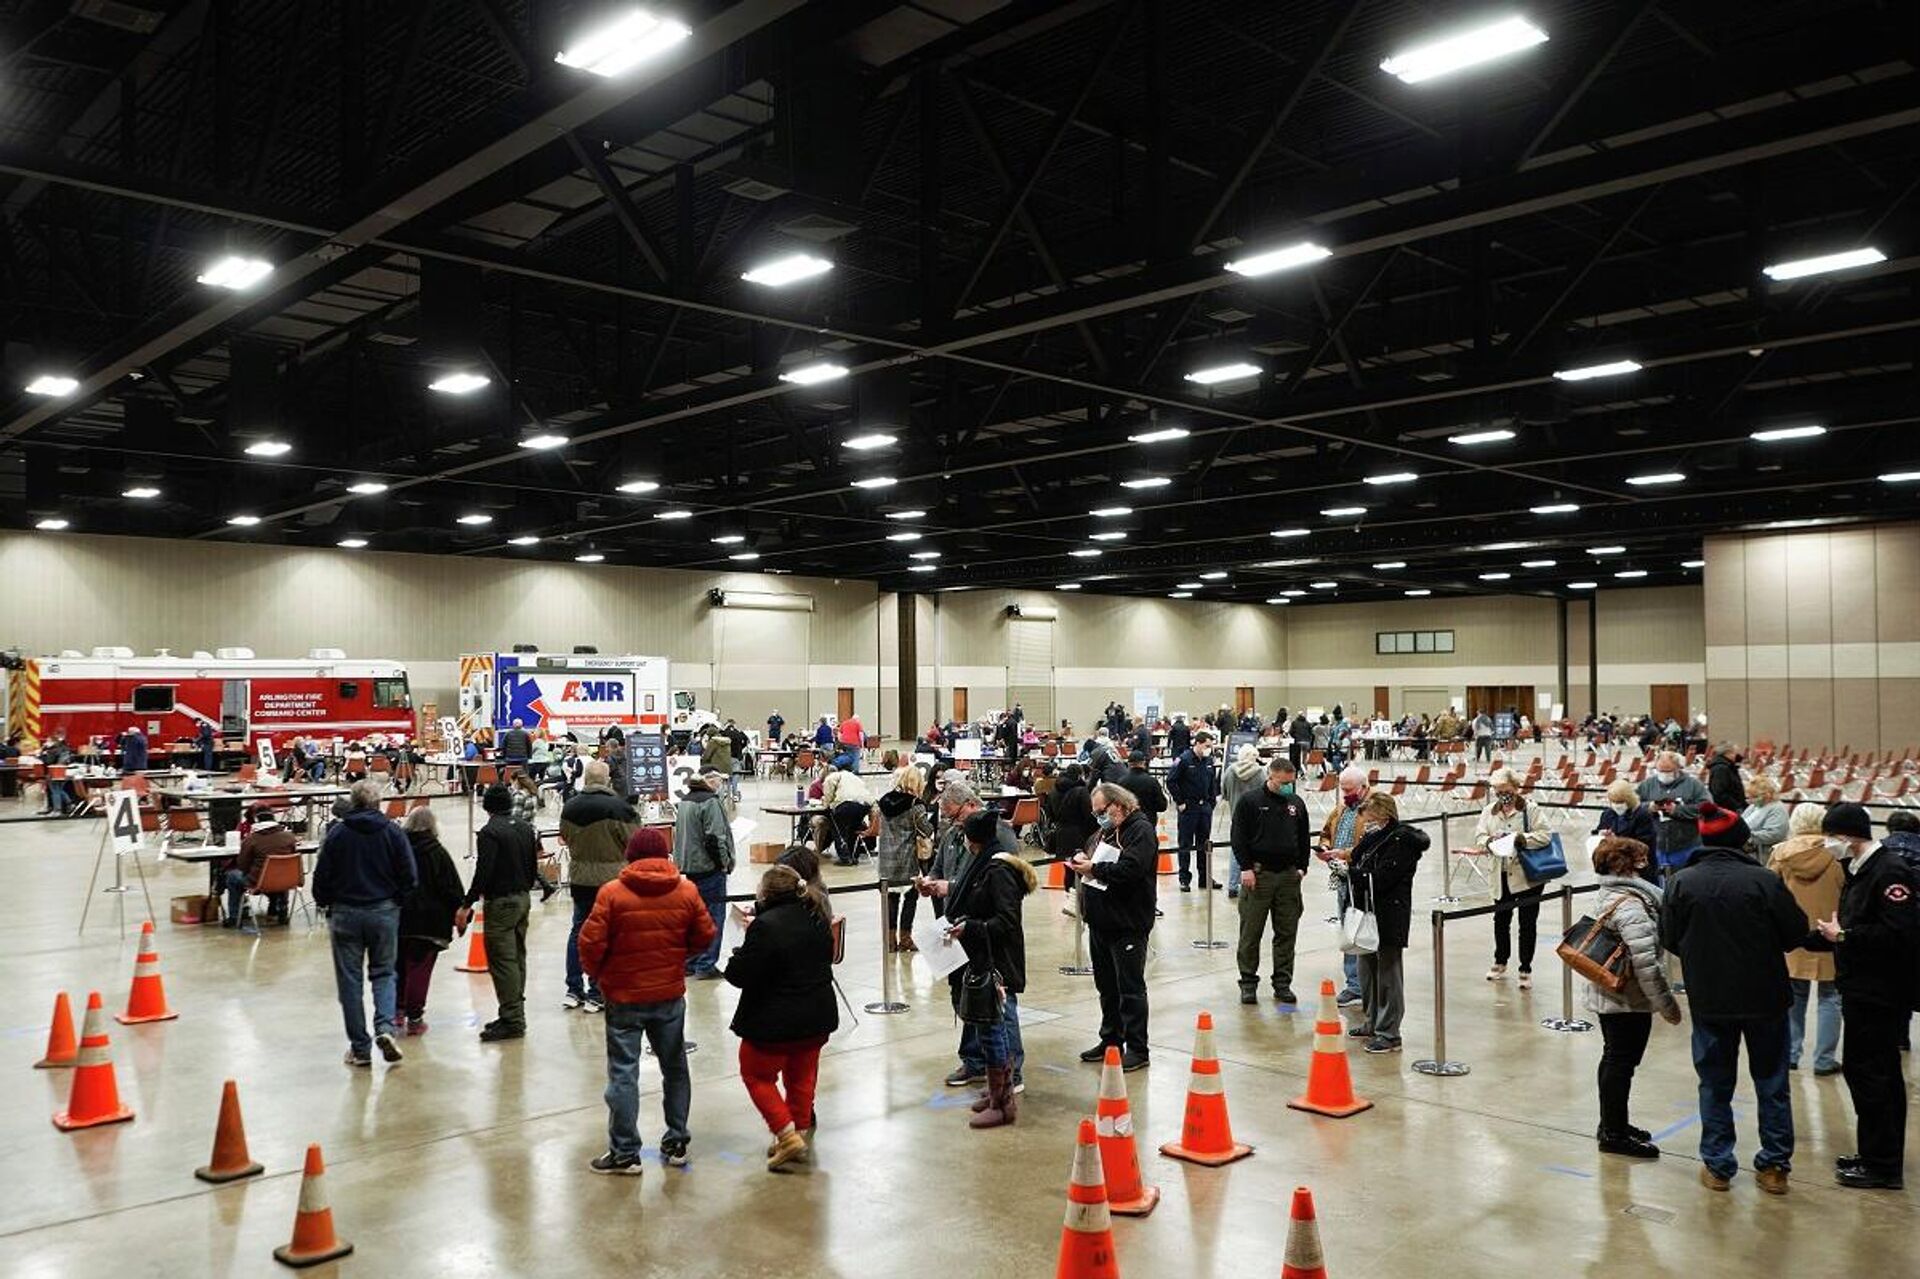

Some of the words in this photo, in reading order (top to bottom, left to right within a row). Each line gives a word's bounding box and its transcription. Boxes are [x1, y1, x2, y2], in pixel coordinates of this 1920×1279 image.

[258, 693, 304, 701] ARLINGTON
[305, 693, 324, 701] FIRE
[561, 681, 625, 702] AMR
[264, 701, 317, 709] DEPARTMENT
[254, 709, 295, 718] COMMAND
[296, 709, 327, 717] CENTER
[1374, 723, 1390, 735] 16
[453, 736, 462, 755] 8
[262, 746, 274, 768] 5
[113, 797, 140, 844] 4
